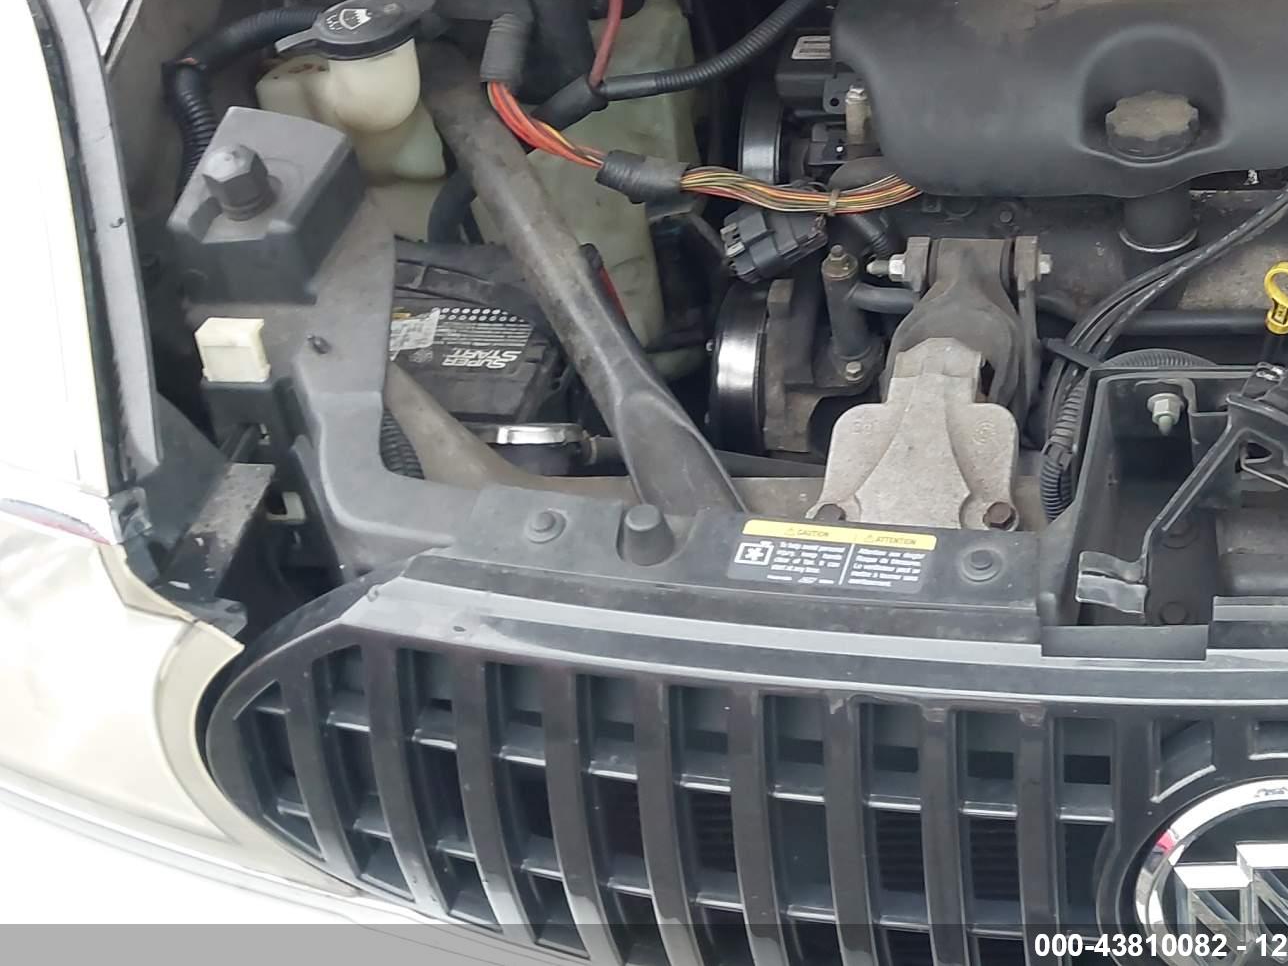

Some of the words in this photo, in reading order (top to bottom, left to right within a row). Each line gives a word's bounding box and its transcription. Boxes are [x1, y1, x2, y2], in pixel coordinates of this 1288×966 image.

[448, 348, 522, 362] START
[442, 356, 507, 369] SUPER
[796, 529, 829, 537] CAUTION
